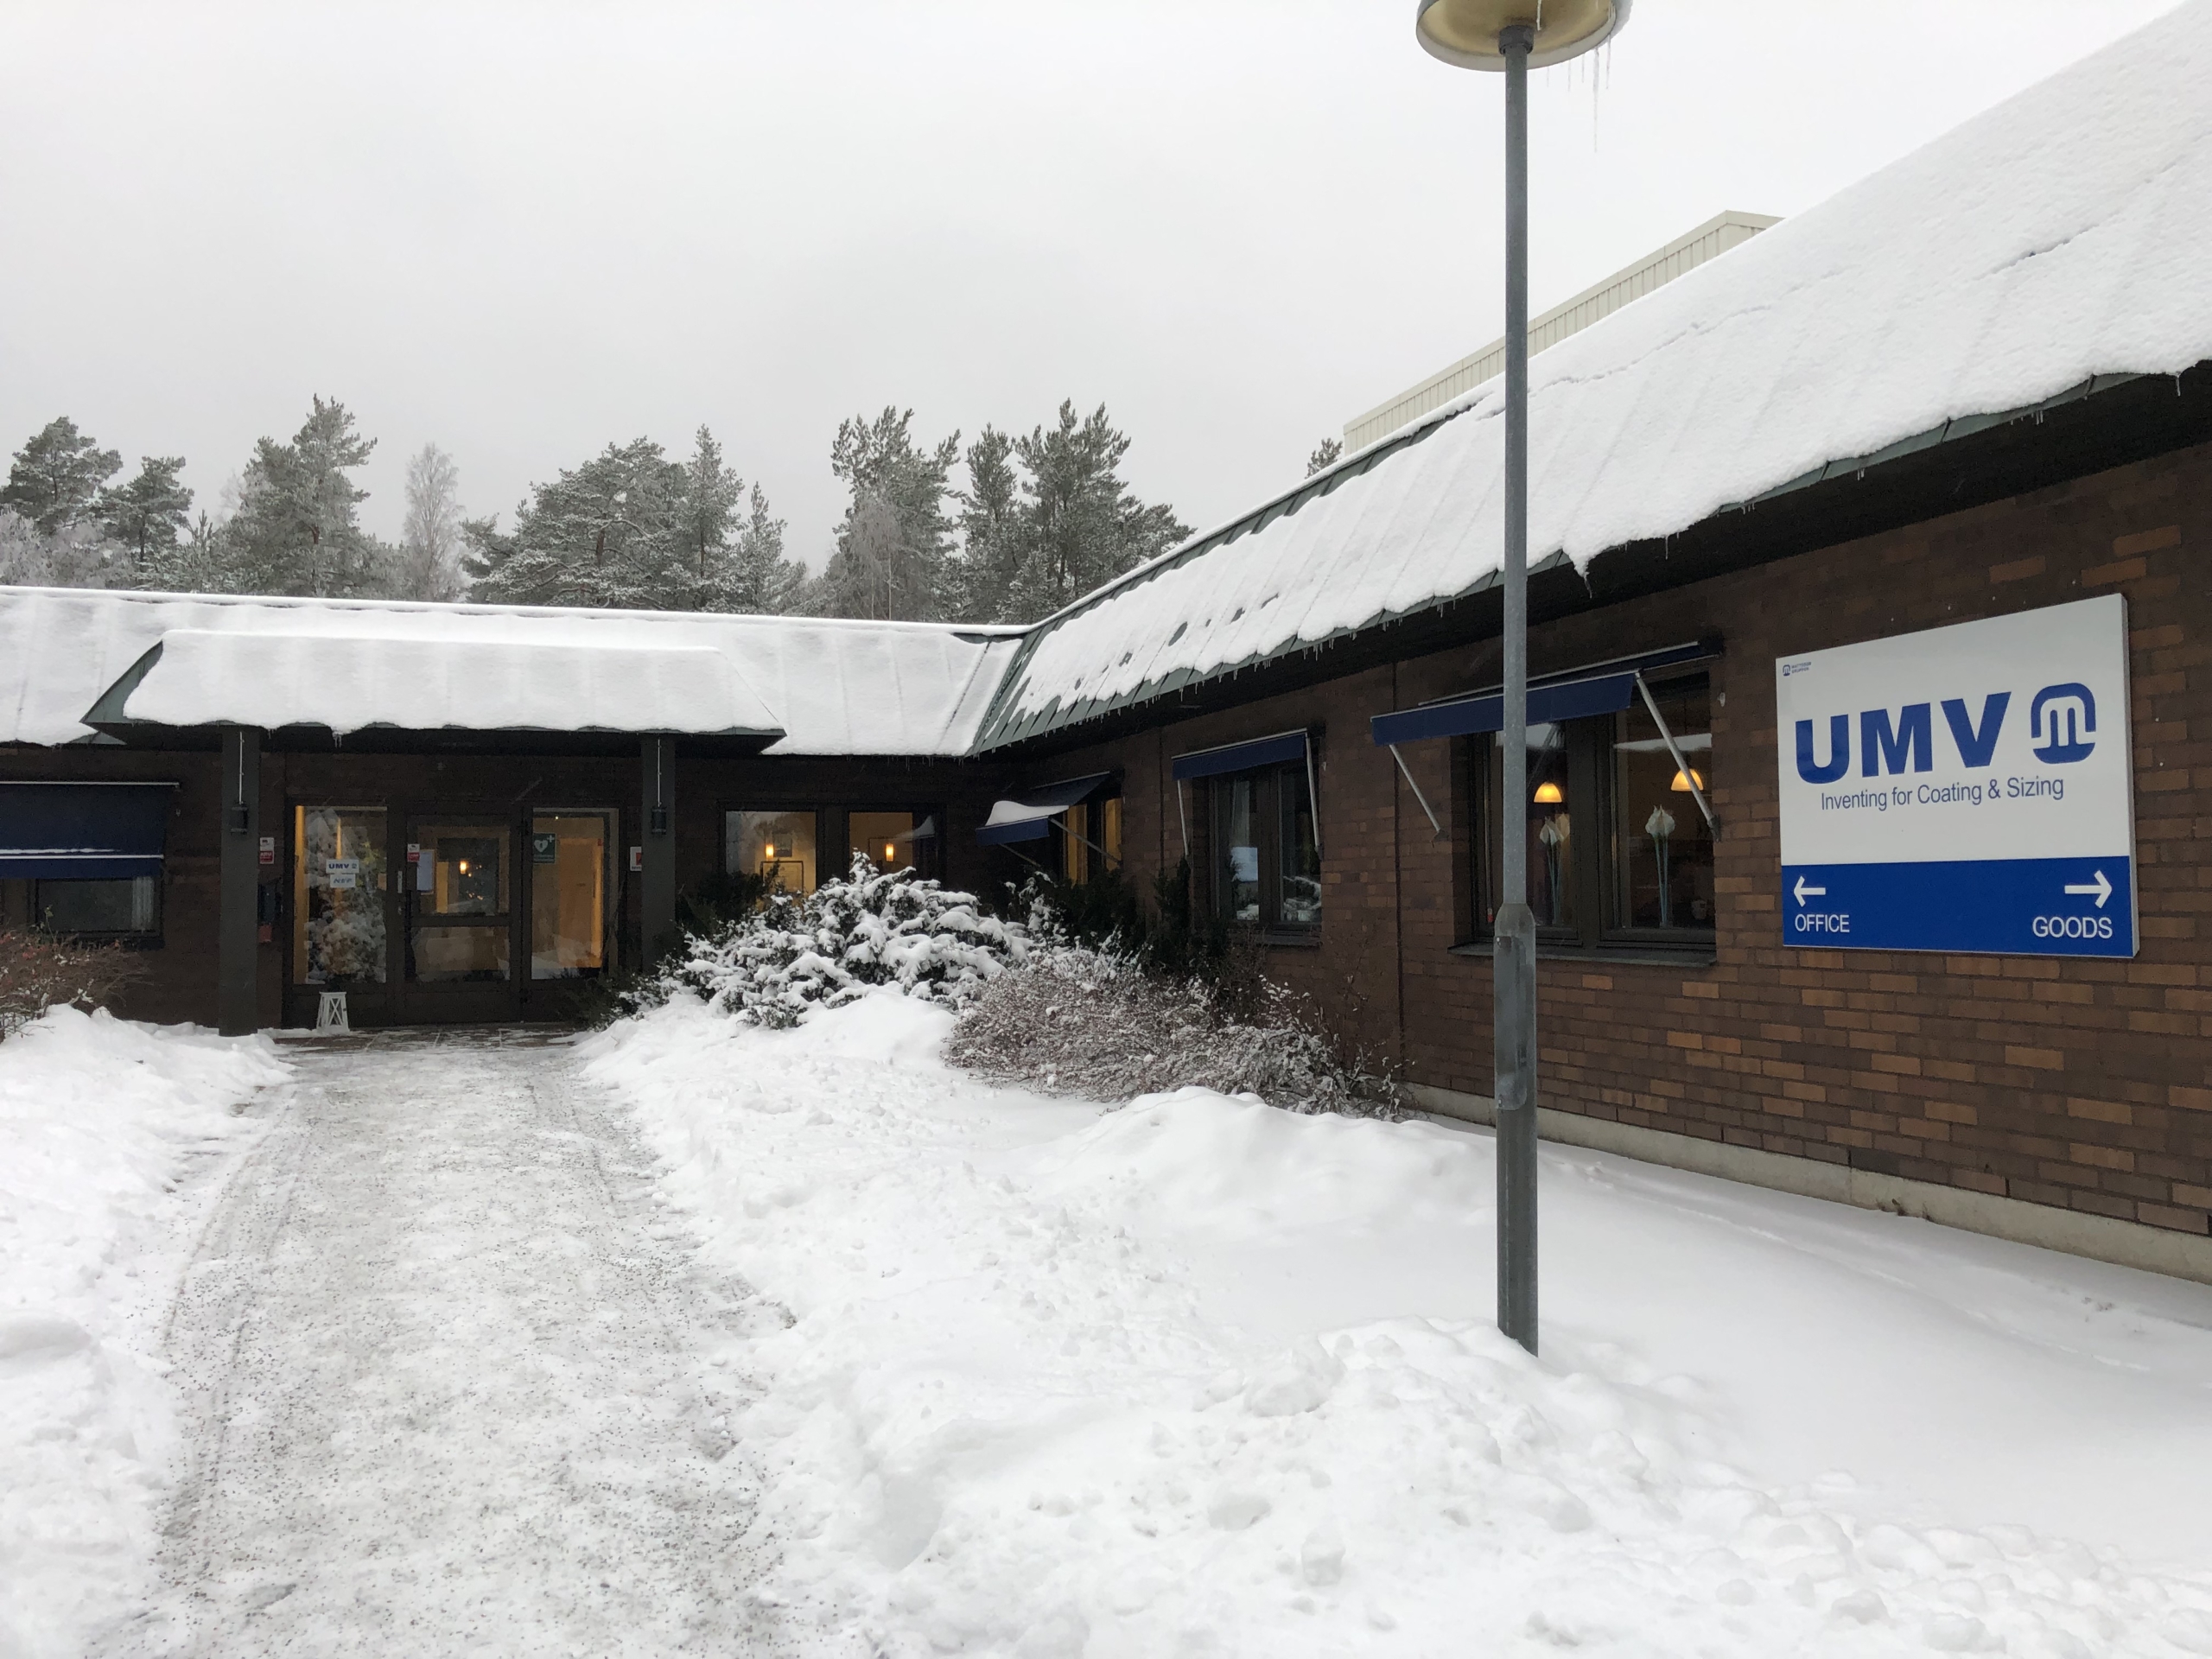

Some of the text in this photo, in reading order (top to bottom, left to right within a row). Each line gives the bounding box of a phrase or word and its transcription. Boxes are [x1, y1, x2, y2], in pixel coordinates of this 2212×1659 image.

[1795, 691, 2012, 785] UMV
[1821, 776, 2064, 811] Inventing for Coating & Sizing
[1795, 914, 1850, 933] OFFICE
[2032, 917, 2113, 939] GOODS
